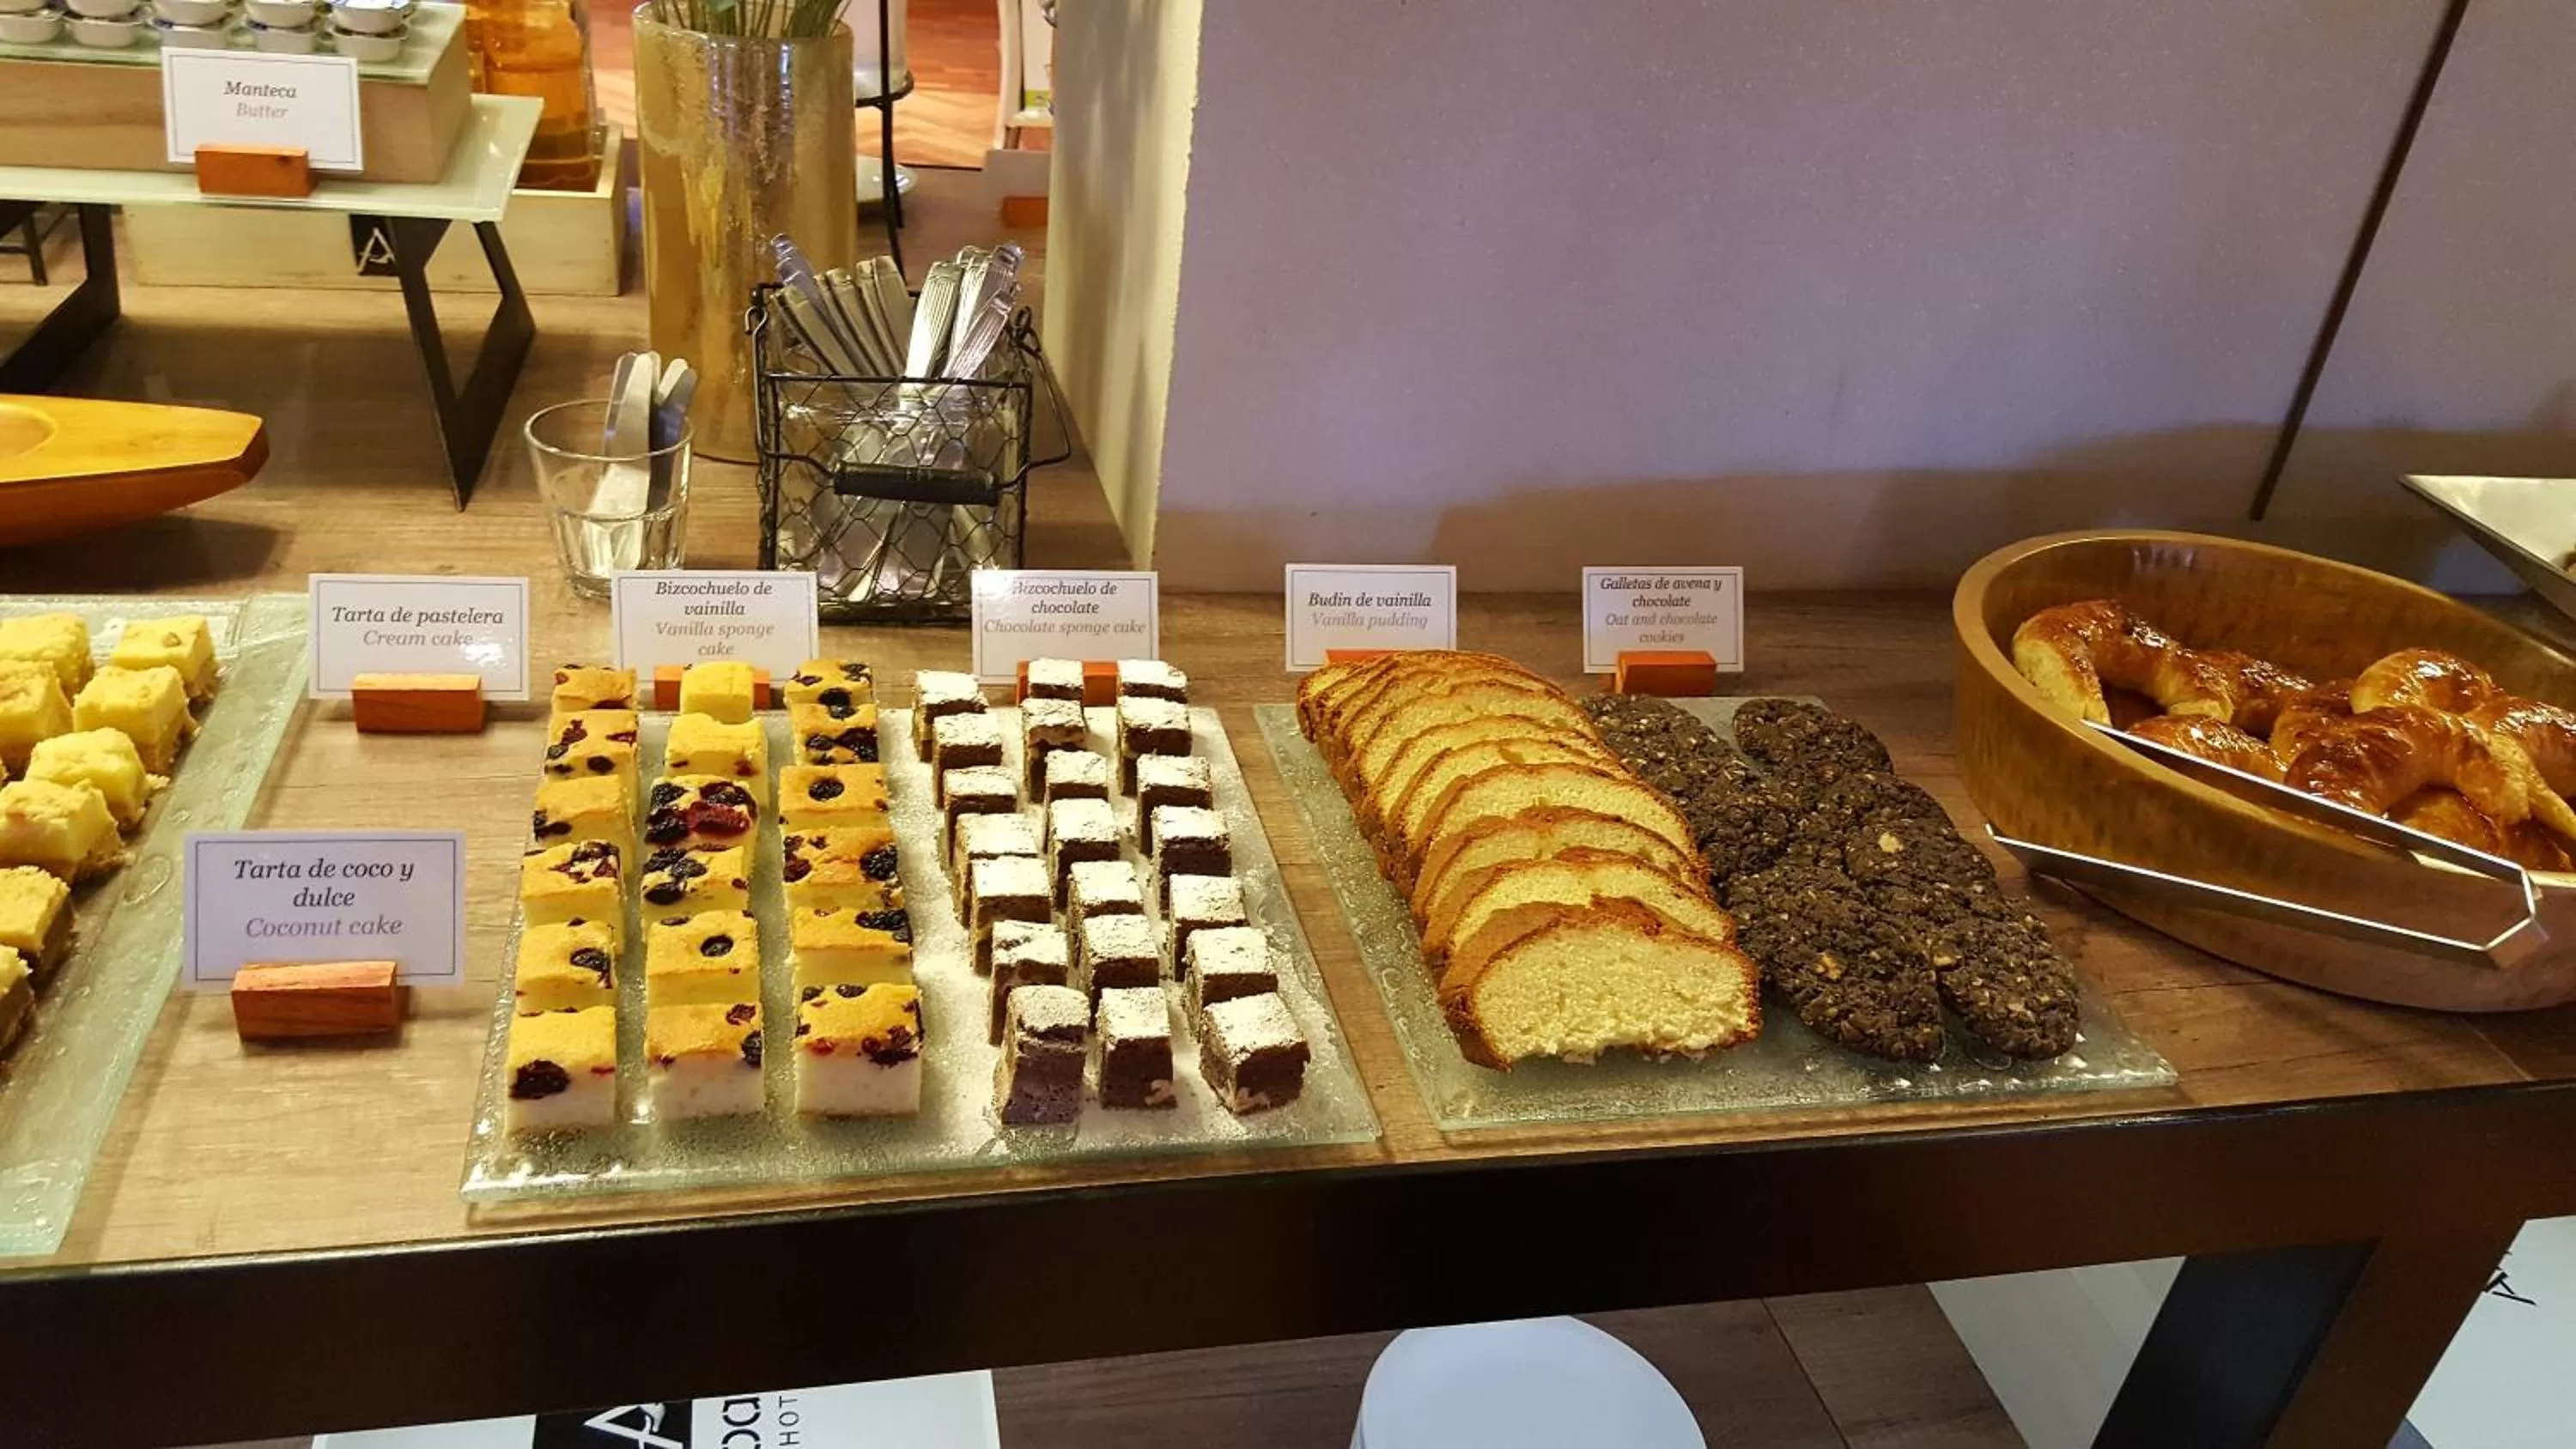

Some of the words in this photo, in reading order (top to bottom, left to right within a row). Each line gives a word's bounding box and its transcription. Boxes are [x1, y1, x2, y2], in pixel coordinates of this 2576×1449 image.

[223, 81, 297, 98] Manteca
[236, 102, 289, 118] Butter
[655, 581, 750, 596] Bizcochuelo
[753, 581, 773, 596] de
[1100, 581, 1118, 595] de
[1600, 577, 1652, 591] Galletas
[1655, 577, 1670, 591] de
[1673, 579, 1711, 590] avena
[1714, 579, 1722, 591] y
[1031, 599, 1100, 614] chocolate
[1356, 591, 1374, 607] de
[1376, 591, 1432, 607] vainilla
[1632, 593, 1692, 608] chocolate
[684, 601, 745, 615] vainilla
[331, 606, 385, 622] Tarta
[391, 606, 412, 622] de
[416, 607, 504, 627] pastelera
[1312, 611, 1364, 627] Vanilla
[1367, 612, 1428, 631] pudding
[1606, 612, 1629, 626] Oat
[1631, 612, 1656, 626] and
[1659, 610, 1718, 626] chocolate
[656, 621, 714, 636] Vanilla
[718, 622, 775, 639] sponge
[984, 619, 1055, 633] Chocolate
[1059, 621, 1110, 637] sponge
[1113, 619, 1146, 634] cake
[363, 629, 426, 646] Cream
[432, 629, 474, 646] cake
[1638, 630, 1685, 643] cookies
[697, 641, 735, 656] cake
[234, 859, 301, 879] Tarta
[308, 858, 336, 879] de
[343, 861, 394, 878] coco
[399, 862, 415, 882] y
[293, 886, 355, 907] dulce
[246, 916, 342, 938] Coconut
[349, 914, 404, 936] cake
[779, 1395, 800, 1447] HOT
